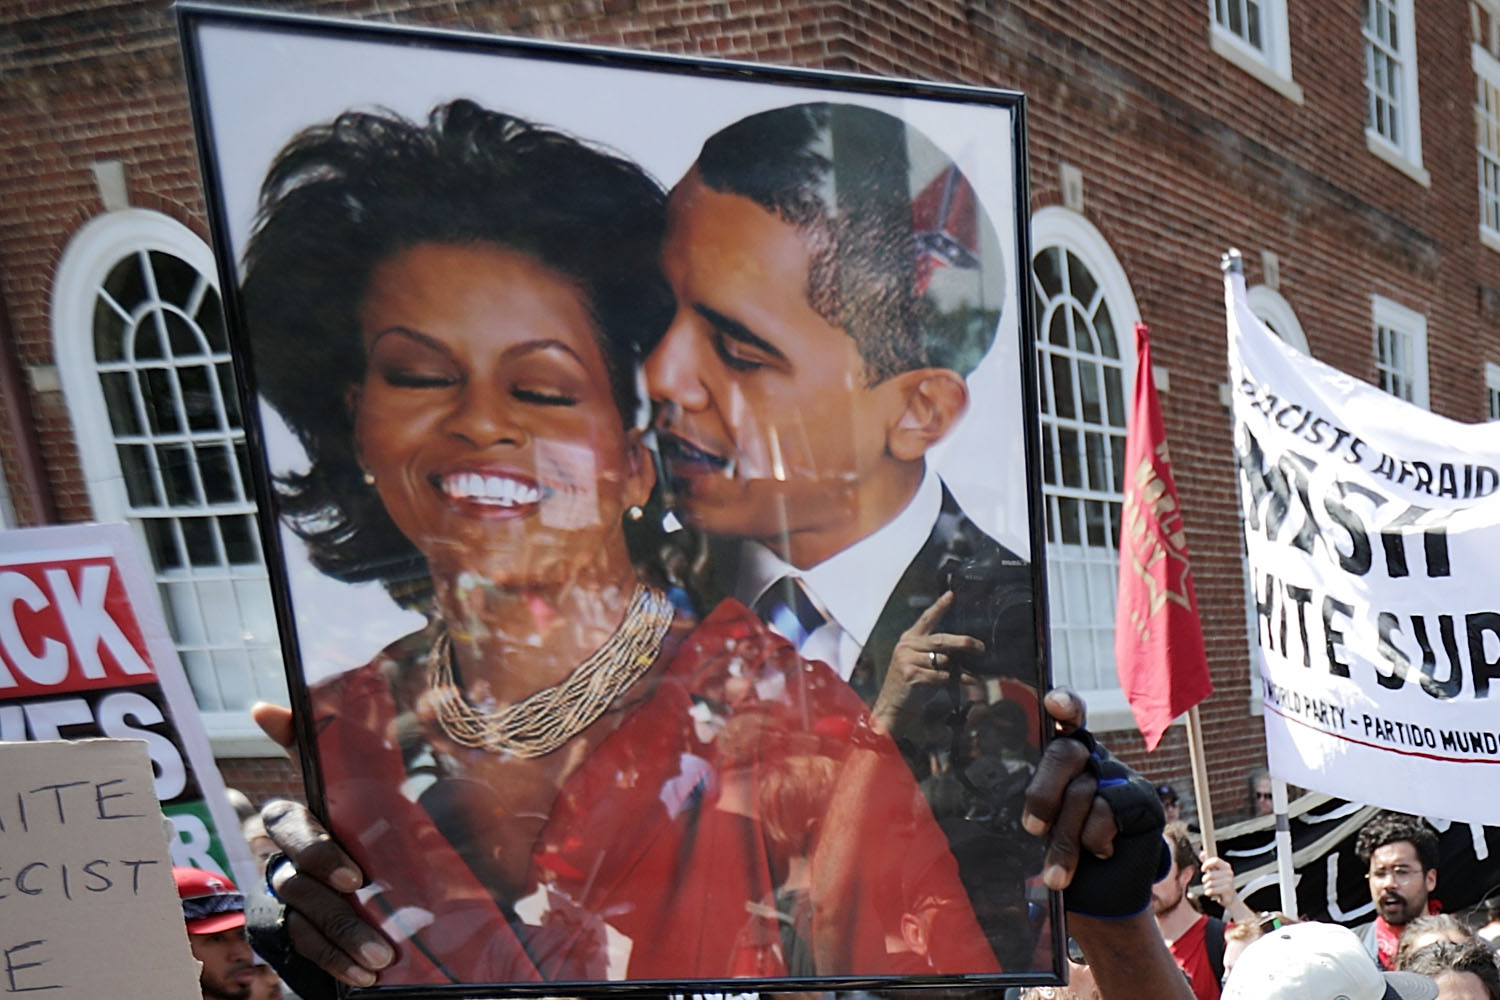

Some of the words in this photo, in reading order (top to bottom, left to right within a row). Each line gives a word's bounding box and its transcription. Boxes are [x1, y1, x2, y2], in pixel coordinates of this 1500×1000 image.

[1371, 452, 1499, 500] AFRAID
[0, 565, 152, 687] CK
[1303, 696, 1345, 729] PARTY
[1362, 714, 1436, 749] PARTIDO
[0, 778, 146, 833] ITE
